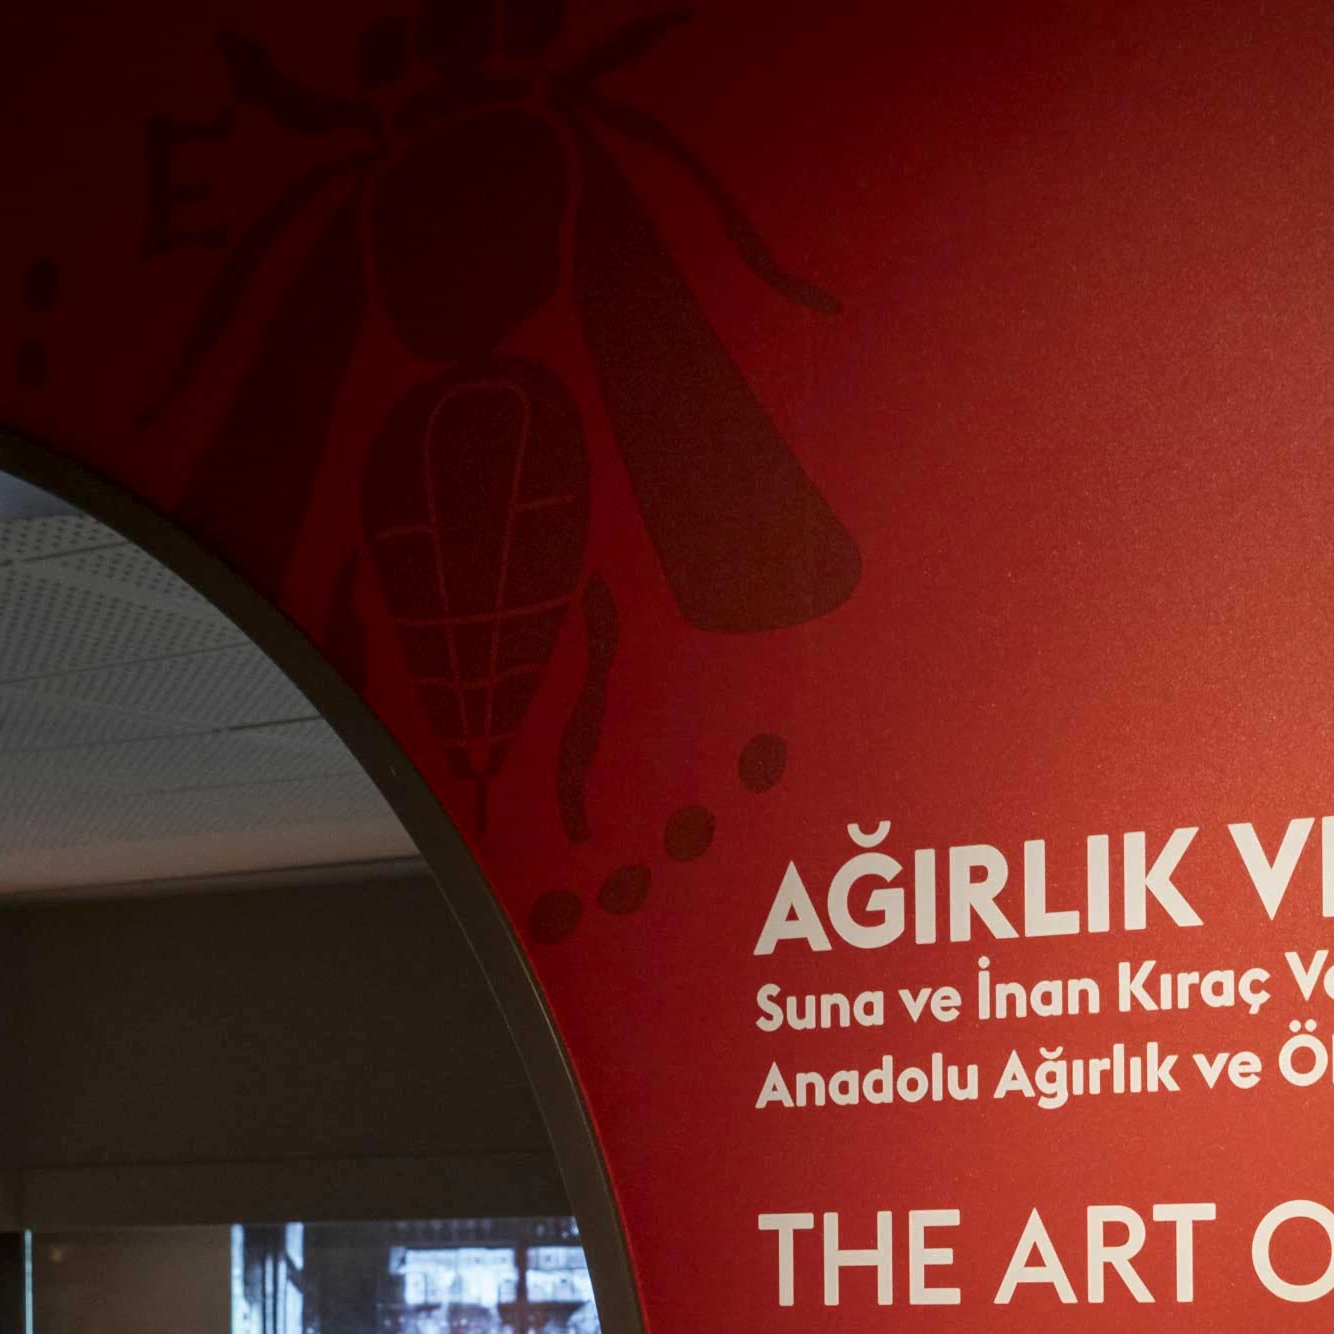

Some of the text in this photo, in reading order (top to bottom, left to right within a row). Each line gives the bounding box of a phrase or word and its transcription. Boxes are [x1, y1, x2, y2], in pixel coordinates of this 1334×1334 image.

[753, 820, 1205, 956] AĞIRLIK
[755, 983, 885, 1032] Suna
[898, 986, 962, 1023] ve
[977, 955, 1101, 1020] İnan
[1118, 959, 1271, 1015] Kıraç
[755, 1052, 979, 1109] Anadolu
[993, 1041, 1181, 1110] Ağırlık
[1192, 1050, 1263, 1090] ve
[758, 1208, 961, 1307] THE
[993, 1202, 1217, 1305] ART
